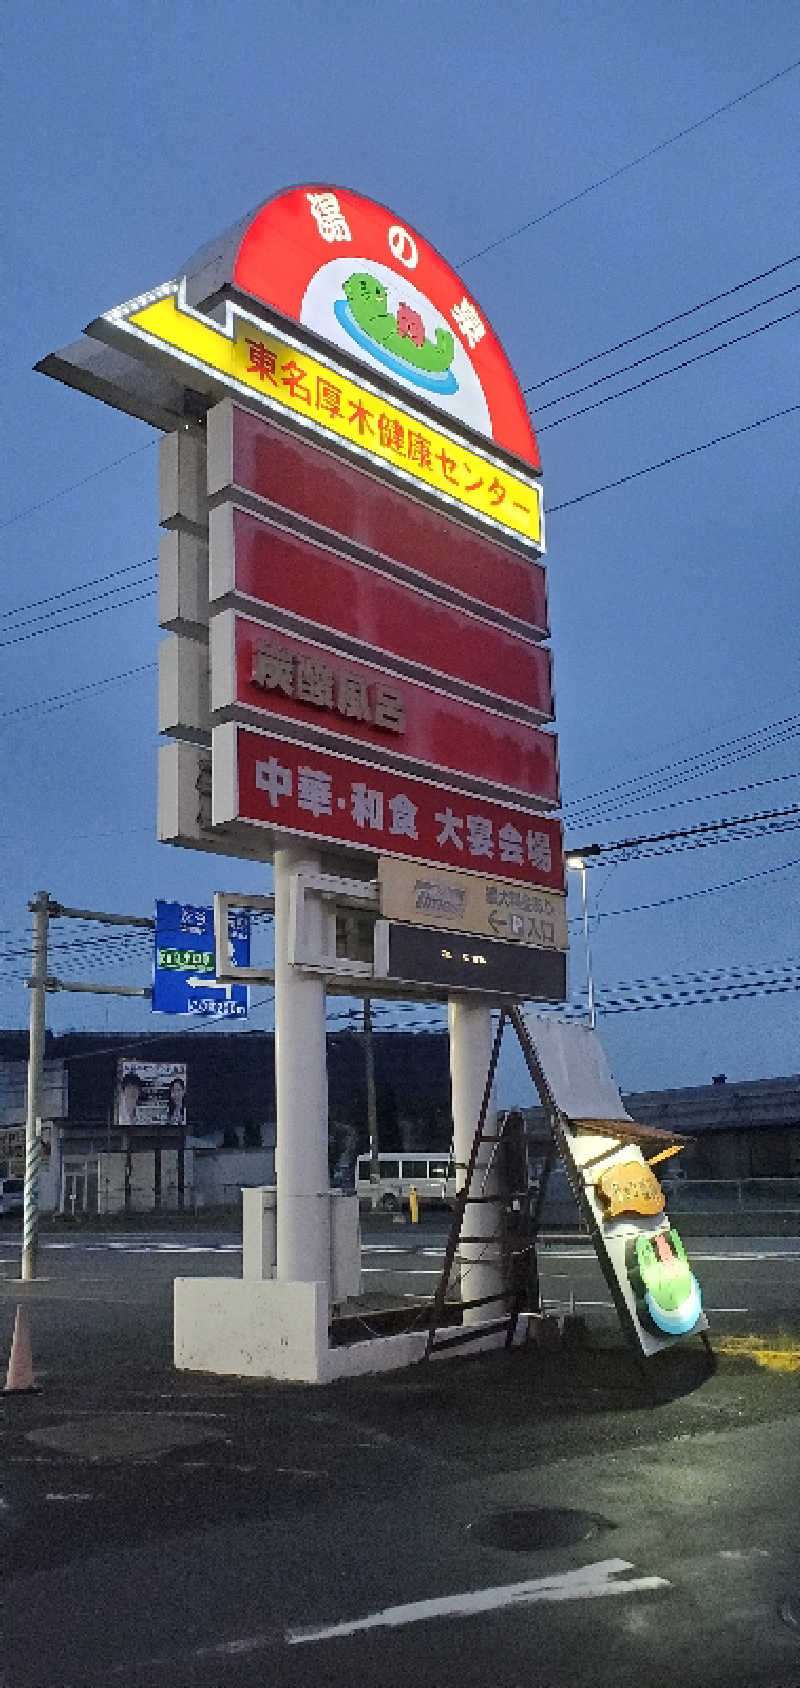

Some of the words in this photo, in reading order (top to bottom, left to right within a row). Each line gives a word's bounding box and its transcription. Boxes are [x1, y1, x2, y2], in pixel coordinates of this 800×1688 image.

[245, 337, 531, 515] 東名厚木健康センター
[251, 638, 405, 735] 炭酸風呂
[434, 806, 551, 872] 大宴会場
